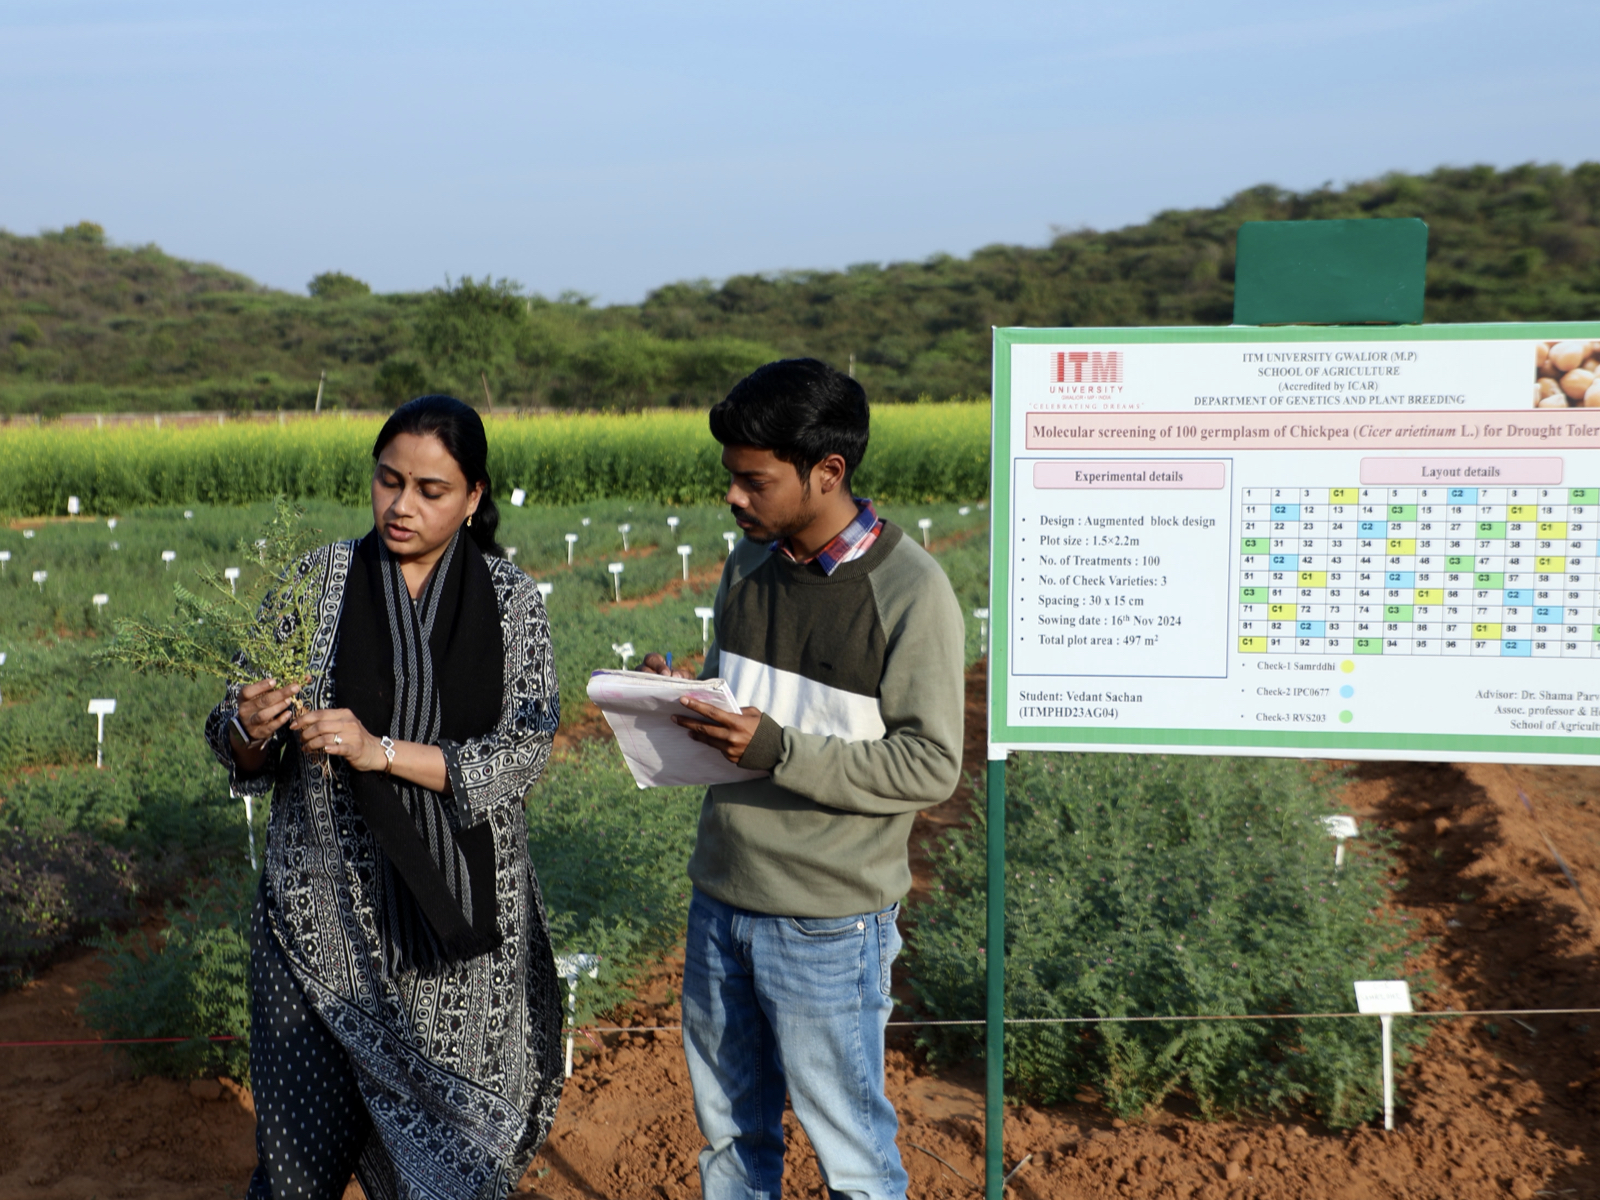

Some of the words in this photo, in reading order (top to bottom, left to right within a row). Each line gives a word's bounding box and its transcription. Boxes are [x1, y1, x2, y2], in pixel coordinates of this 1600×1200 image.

[1243, 354, 1264, 362] ITM
[1266, 353, 1332, 362] UNIVERSITY
[1335, 352, 1388, 361] GWALIOR
[1391, 352, 1417, 362] (M.P)
[1050, 352, 1123, 382] ITM
[1258, 368, 1302, 377] SCHOOL
[1305, 367, 1319, 376] OF
[1321, 367, 1400, 376] AGRICULTURE
[1278, 382, 1331, 392] (Accredited
[1334, 382, 1344, 392] by
[1348, 381, 1378, 391] ICAR)
[1194, 396, 1266, 406] DEPARTMENT
[1269, 396, 1284, 405] OF
[1286, 396, 1340, 405] GENETICS
[1343, 396, 1366, 405] AND
[1369, 396, 1405, 404] PLANT
[1408, 395, 1465, 404] BREEDING
[1033, 426, 1095, 438] Molecular
[1098, 426, 1156, 440] screening
[1160, 426, 1172, 438] of
[1176, 426, 1196, 438] 100
[1200, 426, 1270, 440] germplasm
[1274, 426, 1286, 437] of
[1290, 425, 1349, 440] Chickpea
[1353, 425, 1391, 438] (Cicer
[1395, 426, 1456, 437] arietinum
[1460, 424, 1479, 438] L.)
[1483, 424, 1502, 437] for
[1507, 424, 1561, 440] Drought
[1075, 471, 1146, 484] Experimental
[1149, 471, 1183, 482] details
[1421, 466, 1460, 478] Layout
[1464, 466, 1500, 477] details
[1040, 515, 1074, 528] Design
[1084, 516, 1144, 528] Augmented
[1151, 516, 1179, 526] block
[1182, 516, 1215, 529] design
[1040, 536, 1060, 546] Plot
[1063, 536, 1082, 546] size
[1040, 556, 1057, 565] No.
[1060, 556, 1070, 566] of
[1073, 556, 1132, 566] Treatments
[1142, 556, 1160, 566] 100
[1039, 575, 1056, 585] No.
[1060, 575, 1070, 585] of
[1073, 575, 1105, 586] Check
[1109, 576, 1157, 586] Varieties:
[1161, 576, 1167, 586] 3
[1038, 596, 1079, 607] Spacing
[1089, 596, 1101, 605] 30
[1114, 596, 1126, 605] 15
[1038, 615, 1076, 627] Sowing
[1079, 615, 1101, 625] date
[1133, 616, 1154, 626] Nov
[1157, 616, 1181, 626] 2024
[1038, 634, 1064, 645] Total
[1068, 635, 1087, 647] plot
[1090, 637, 1113, 646] area
[1123, 635, 1141, 646] 497
[1257, 662, 1291, 670] Check-1
[1294, 662, 1336, 671] Samrddhi
[1019, 691, 1063, 702] Student:
[1066, 692, 1102, 702] Vedant
[1105, 692, 1143, 702] Sachan
[1257, 687, 1291, 696] Check-2
[1293, 688, 1330, 697] IPC0677
[1475, 690, 1517, 700] Advisor:
[1521, 690, 1536, 700] Dr.
[1539, 691, 1572, 701] Shama
[1019, 707, 1118, 720] (ITMPHD23AG04)
[1256, 712, 1290, 722] Check-3
[1293, 713, 1326, 722] RVS203
[1494, 706, 1525, 715] Assoc.
[1528, 706, 1575, 718] professor
[1578, 706, 1586, 716] &
[1510, 720, 1542, 730] School
[1546, 720, 1555, 730] of
